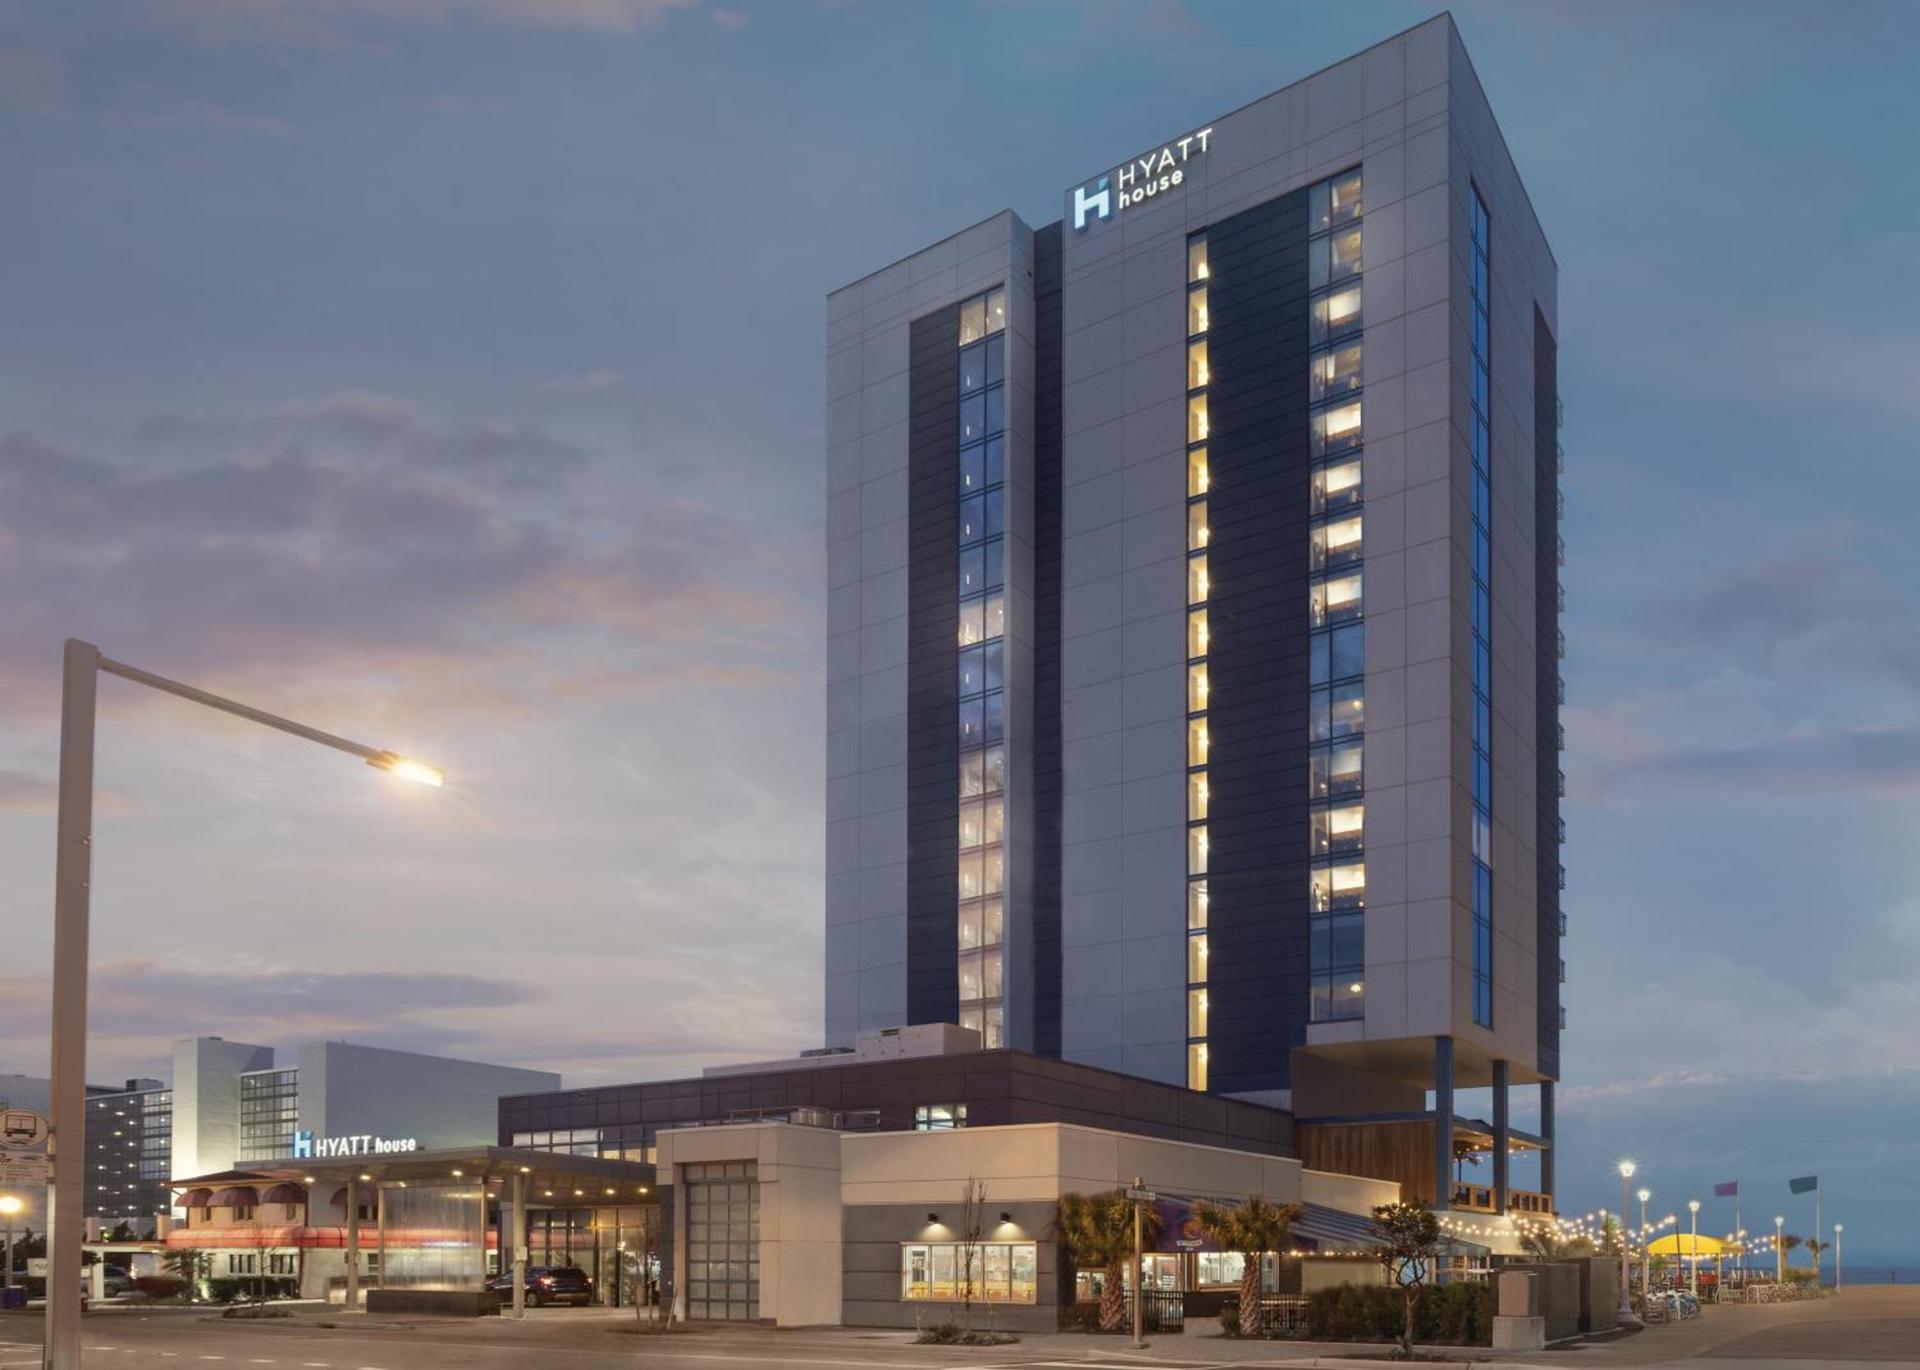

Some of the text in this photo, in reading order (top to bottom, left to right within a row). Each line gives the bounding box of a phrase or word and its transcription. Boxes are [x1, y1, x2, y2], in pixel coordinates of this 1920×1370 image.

[1118, 127, 1213, 190] HYATT
[1118, 169, 1184, 209] house
[316, 1134, 372, 1158] HYATT
[375, 1136, 417, 1154] house
